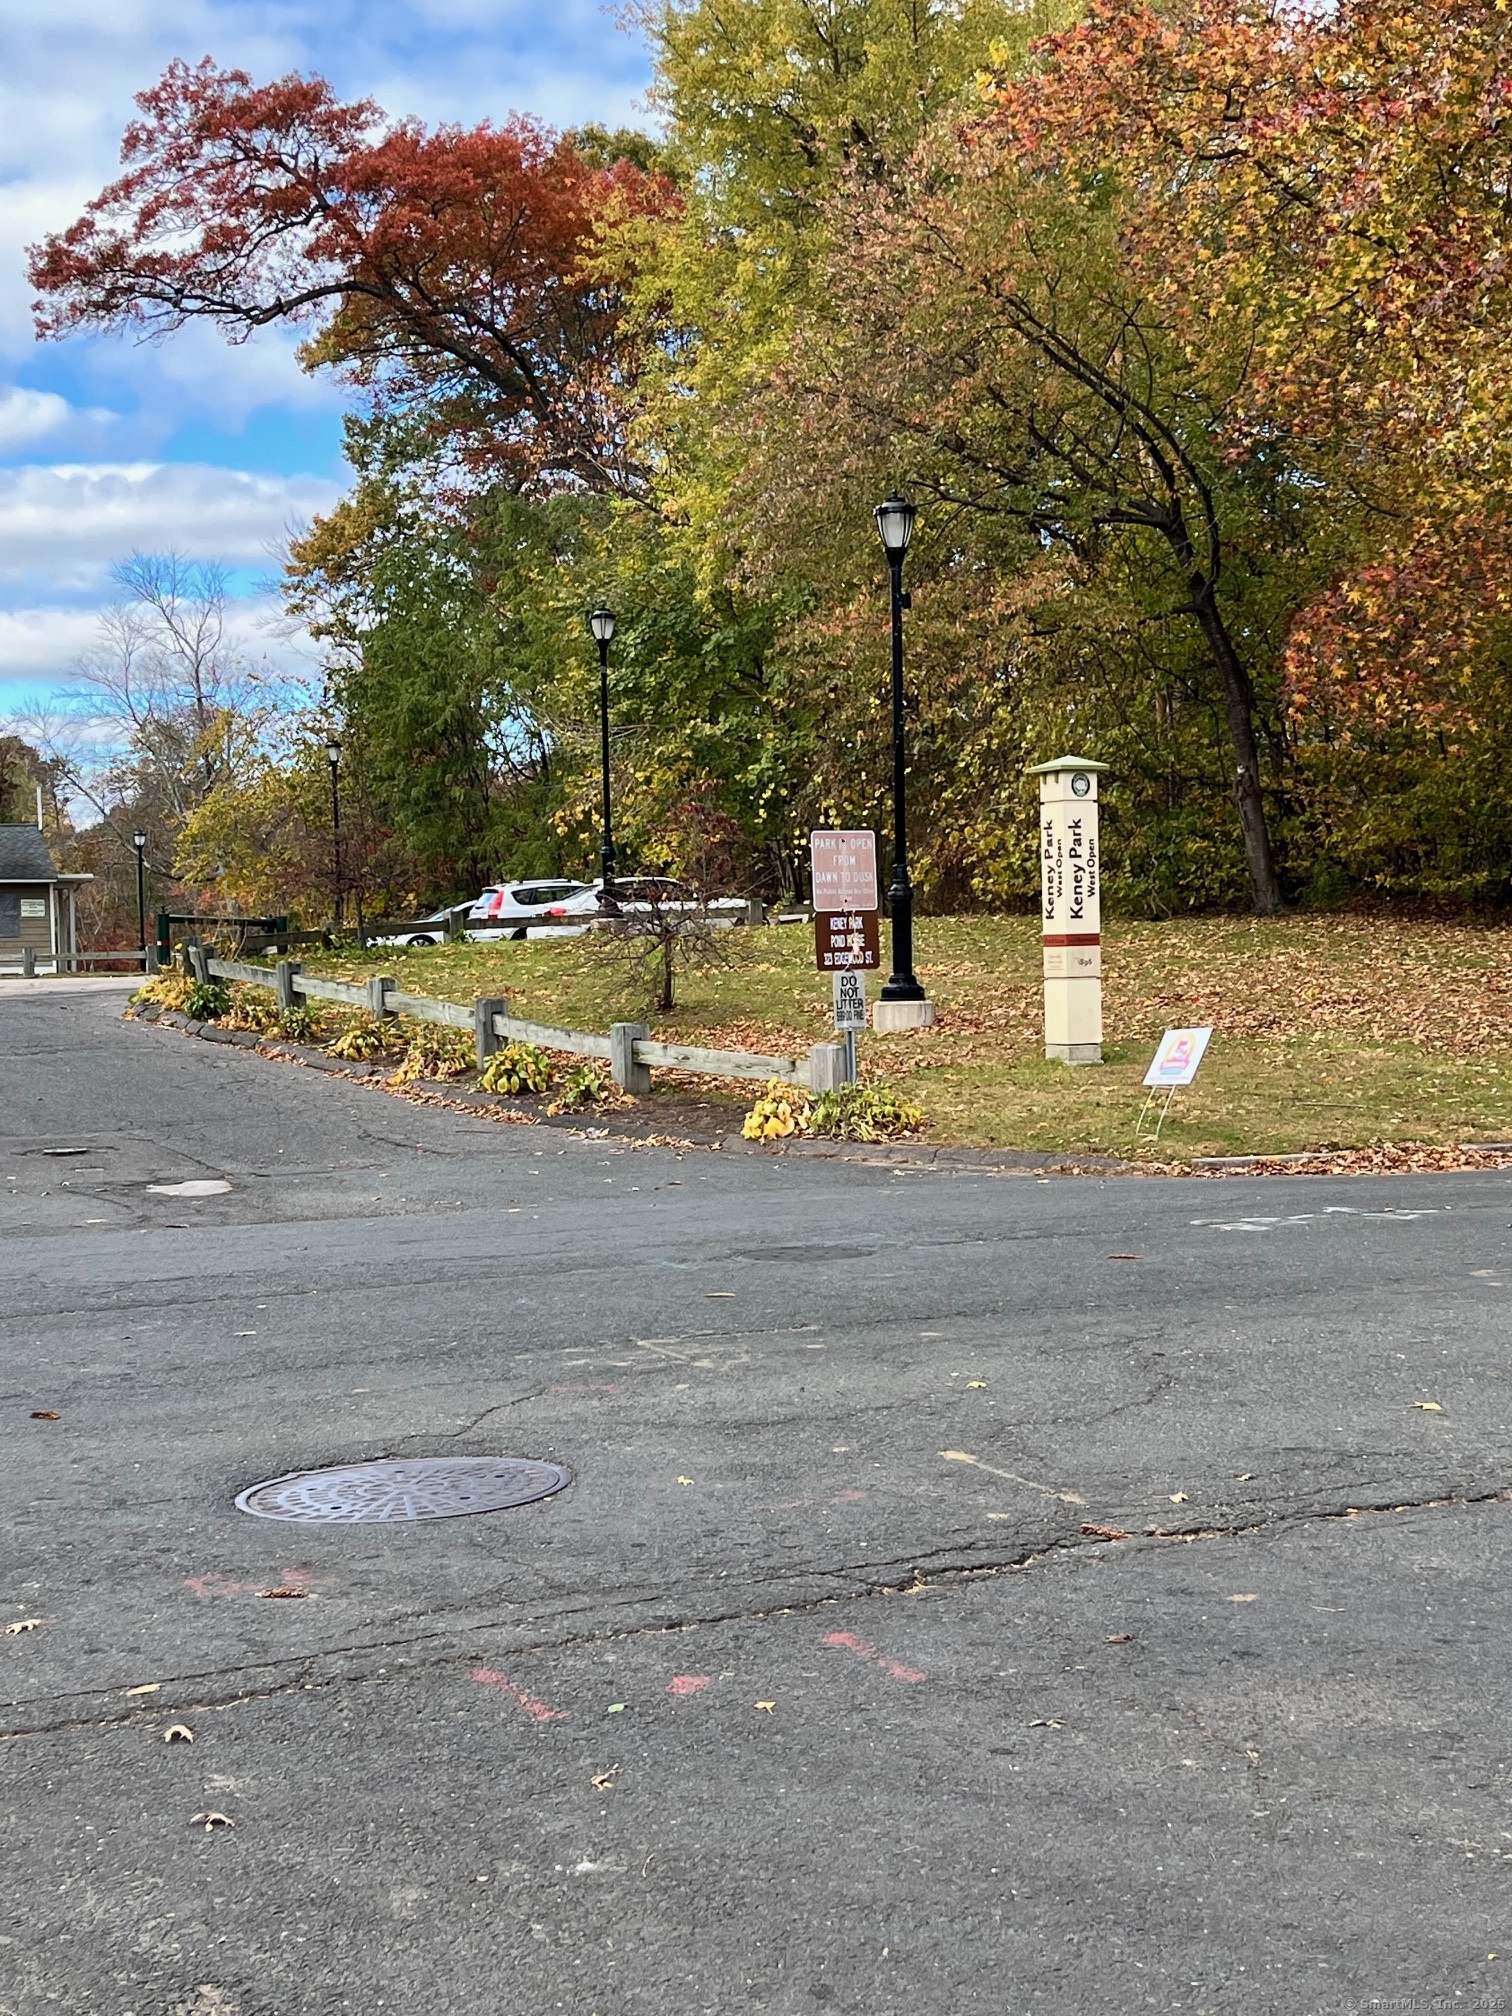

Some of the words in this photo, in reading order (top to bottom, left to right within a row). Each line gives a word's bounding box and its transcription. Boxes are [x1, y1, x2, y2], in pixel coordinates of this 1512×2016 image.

[814, 837, 836, 850] PARK
[850, 837, 872, 850] OPEN
[1043, 819, 1053, 859] Park
[1067, 818, 1082, 858] Park
[833, 854, 856, 866] FROM
[1087, 838, 1097, 868] Open
[815, 871, 838, 884] DAWN
[841, 871, 851, 883] TO
[853, 870, 873, 883] DUSK
[1070, 864, 1086, 919] Keney
[1087, 871, 1096, 898] West
[1045, 865, 1056, 920] Keney
[848, 916, 863, 929] PARK
[830, 934, 845, 948] POND
[846, 934, 865, 947] HOSE
[841, 976, 857, 987] DO
[840, 987, 860, 999] NOT
[836, 998, 864, 1010] LITTER
